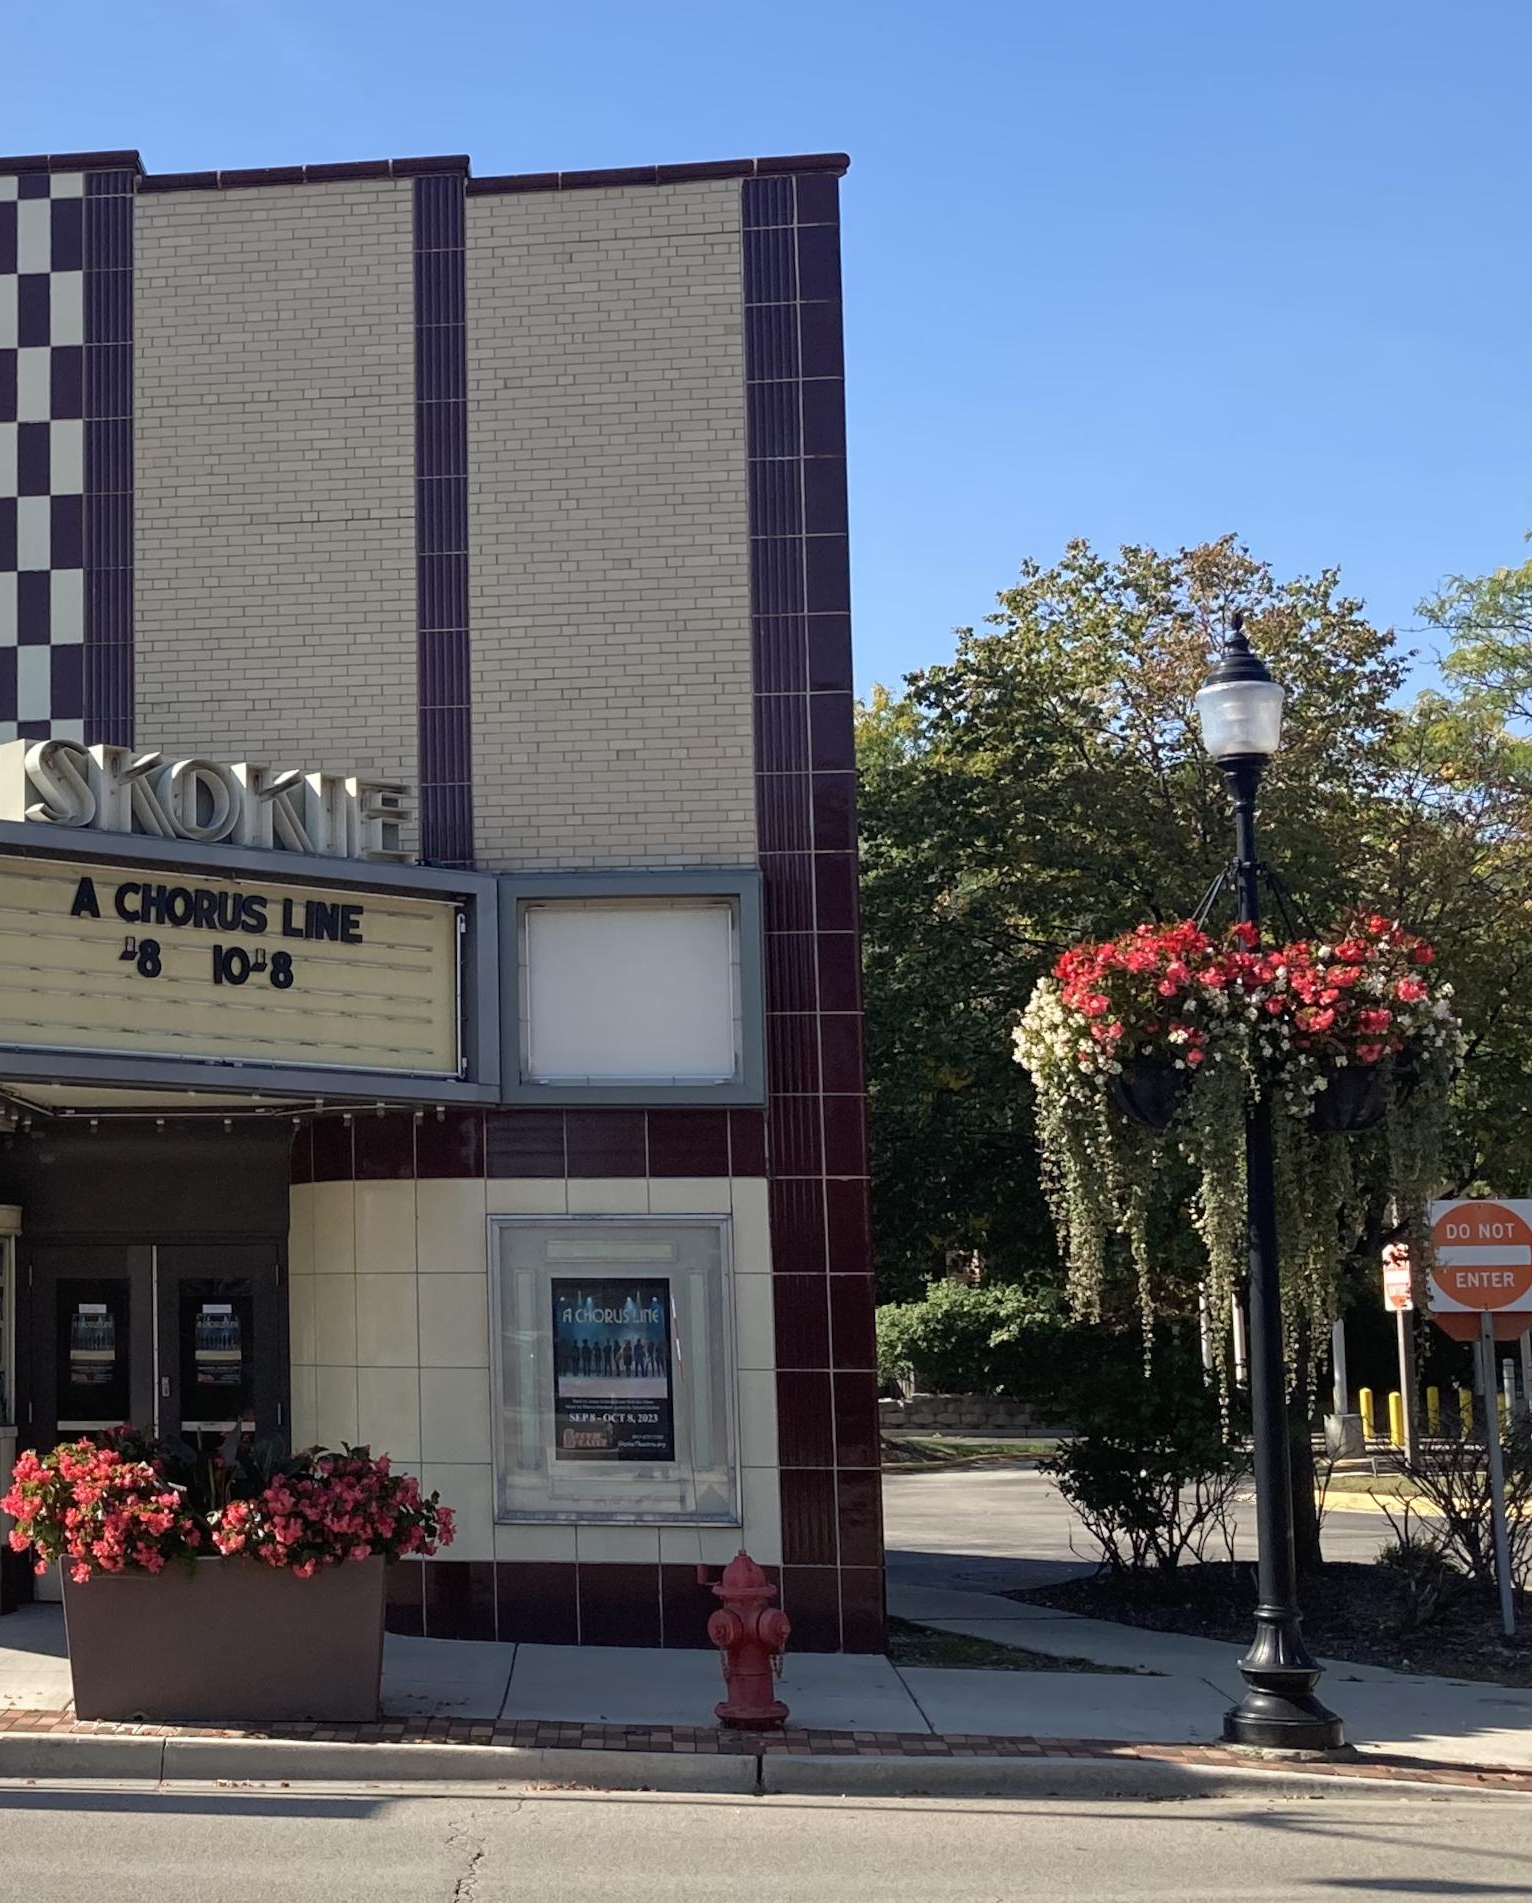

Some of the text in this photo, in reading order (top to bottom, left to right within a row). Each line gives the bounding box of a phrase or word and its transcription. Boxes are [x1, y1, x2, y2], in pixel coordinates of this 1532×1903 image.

[24, 738, 415, 863] SKOKIE
[71, 877, 364, 943] A CHORUS LINE
[1446, 1222, 1515, 1239] DO NOT
[1455, 1271, 1515, 1288] ENTER
[562, 1308, 660, 1324] A CHORUS LINE
[569, 1412, 589, 1423] SEP
[603, 1412, 626, 1424] OCT
[637, 1412, 660, 1424] 2023
